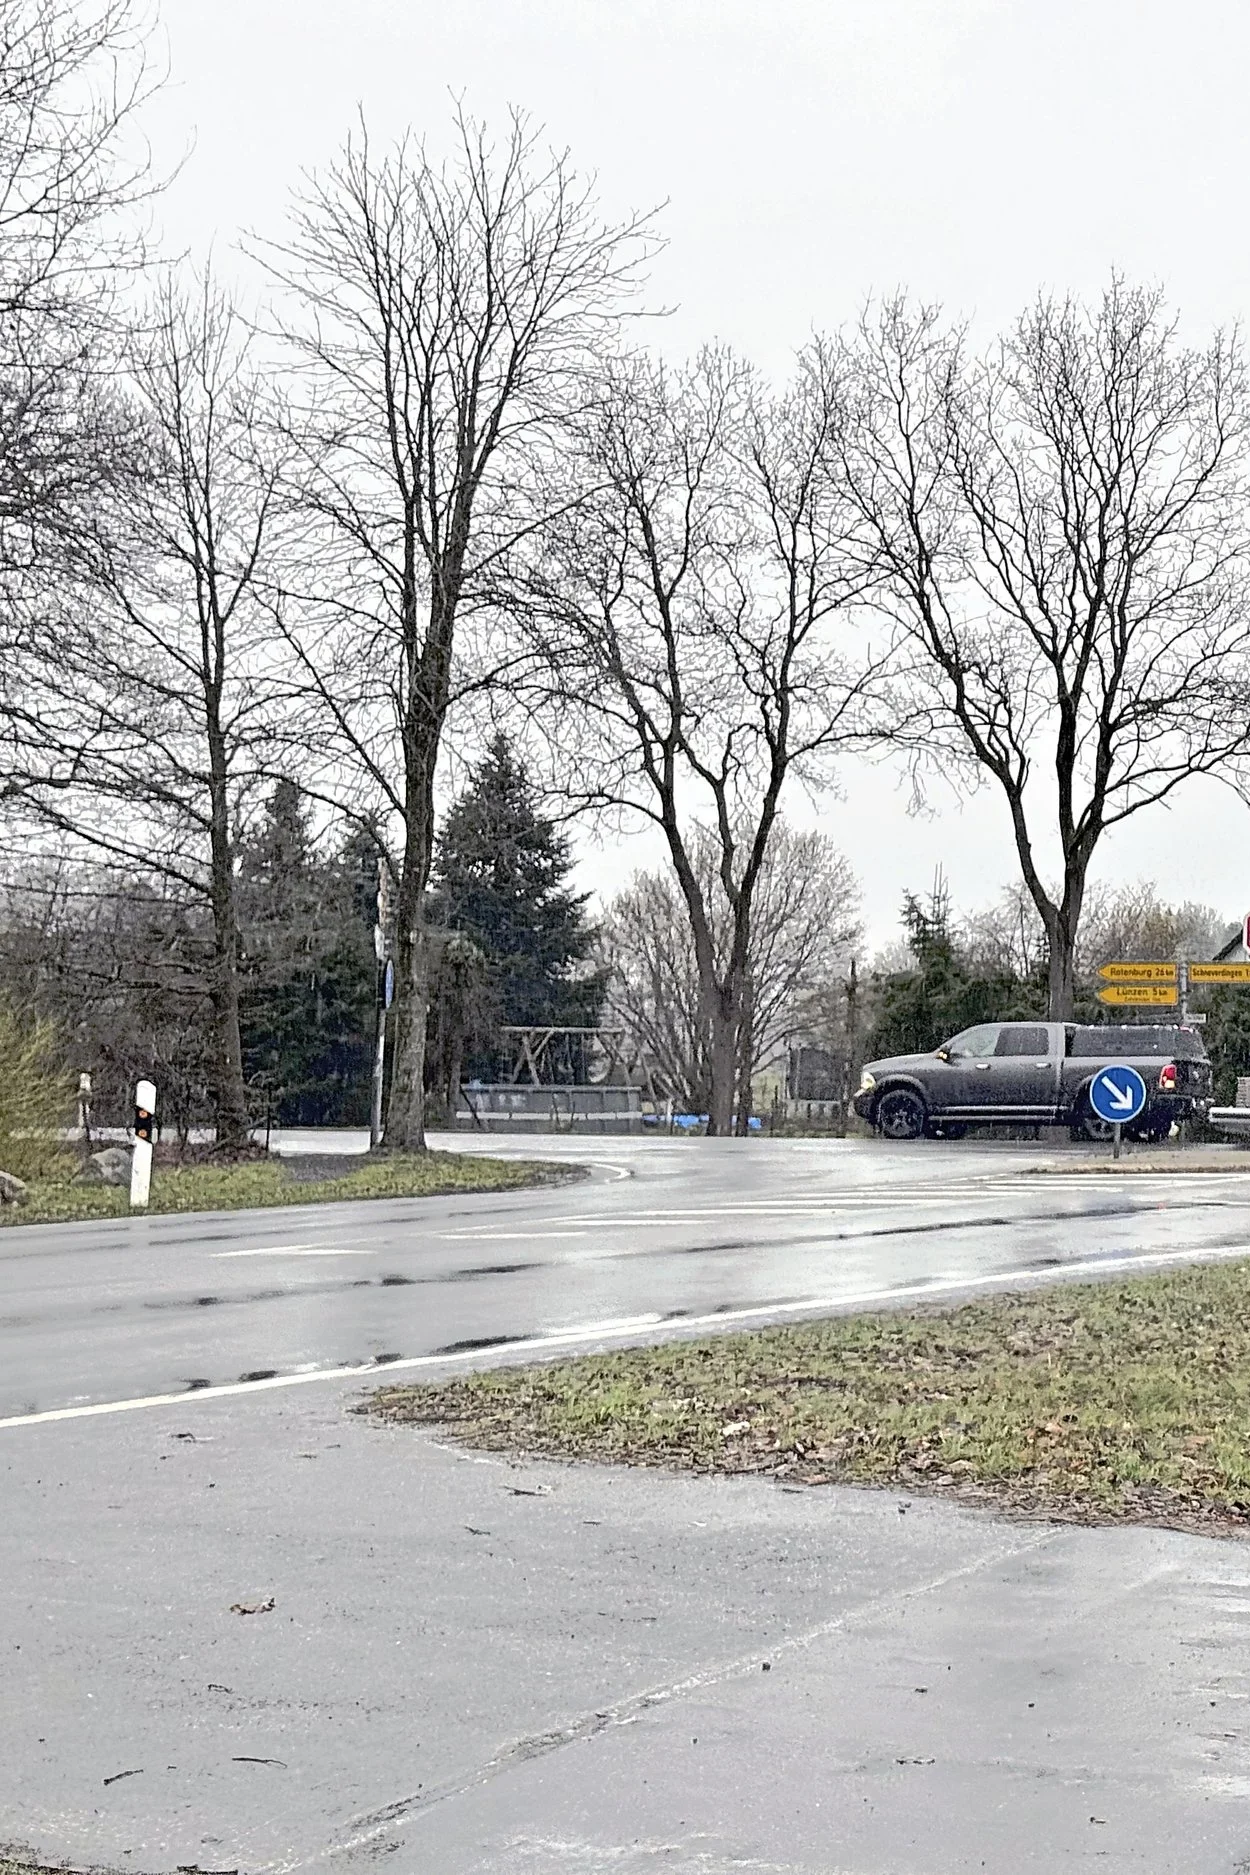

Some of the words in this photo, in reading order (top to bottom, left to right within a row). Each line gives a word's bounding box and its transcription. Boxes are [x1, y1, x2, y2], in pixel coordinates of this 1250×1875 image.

[1110, 967, 1152, 978] Rotenburg
[1192, 968, 1242, 978] Schneverdingen
[1116, 987, 1148, 996] Lünzen
